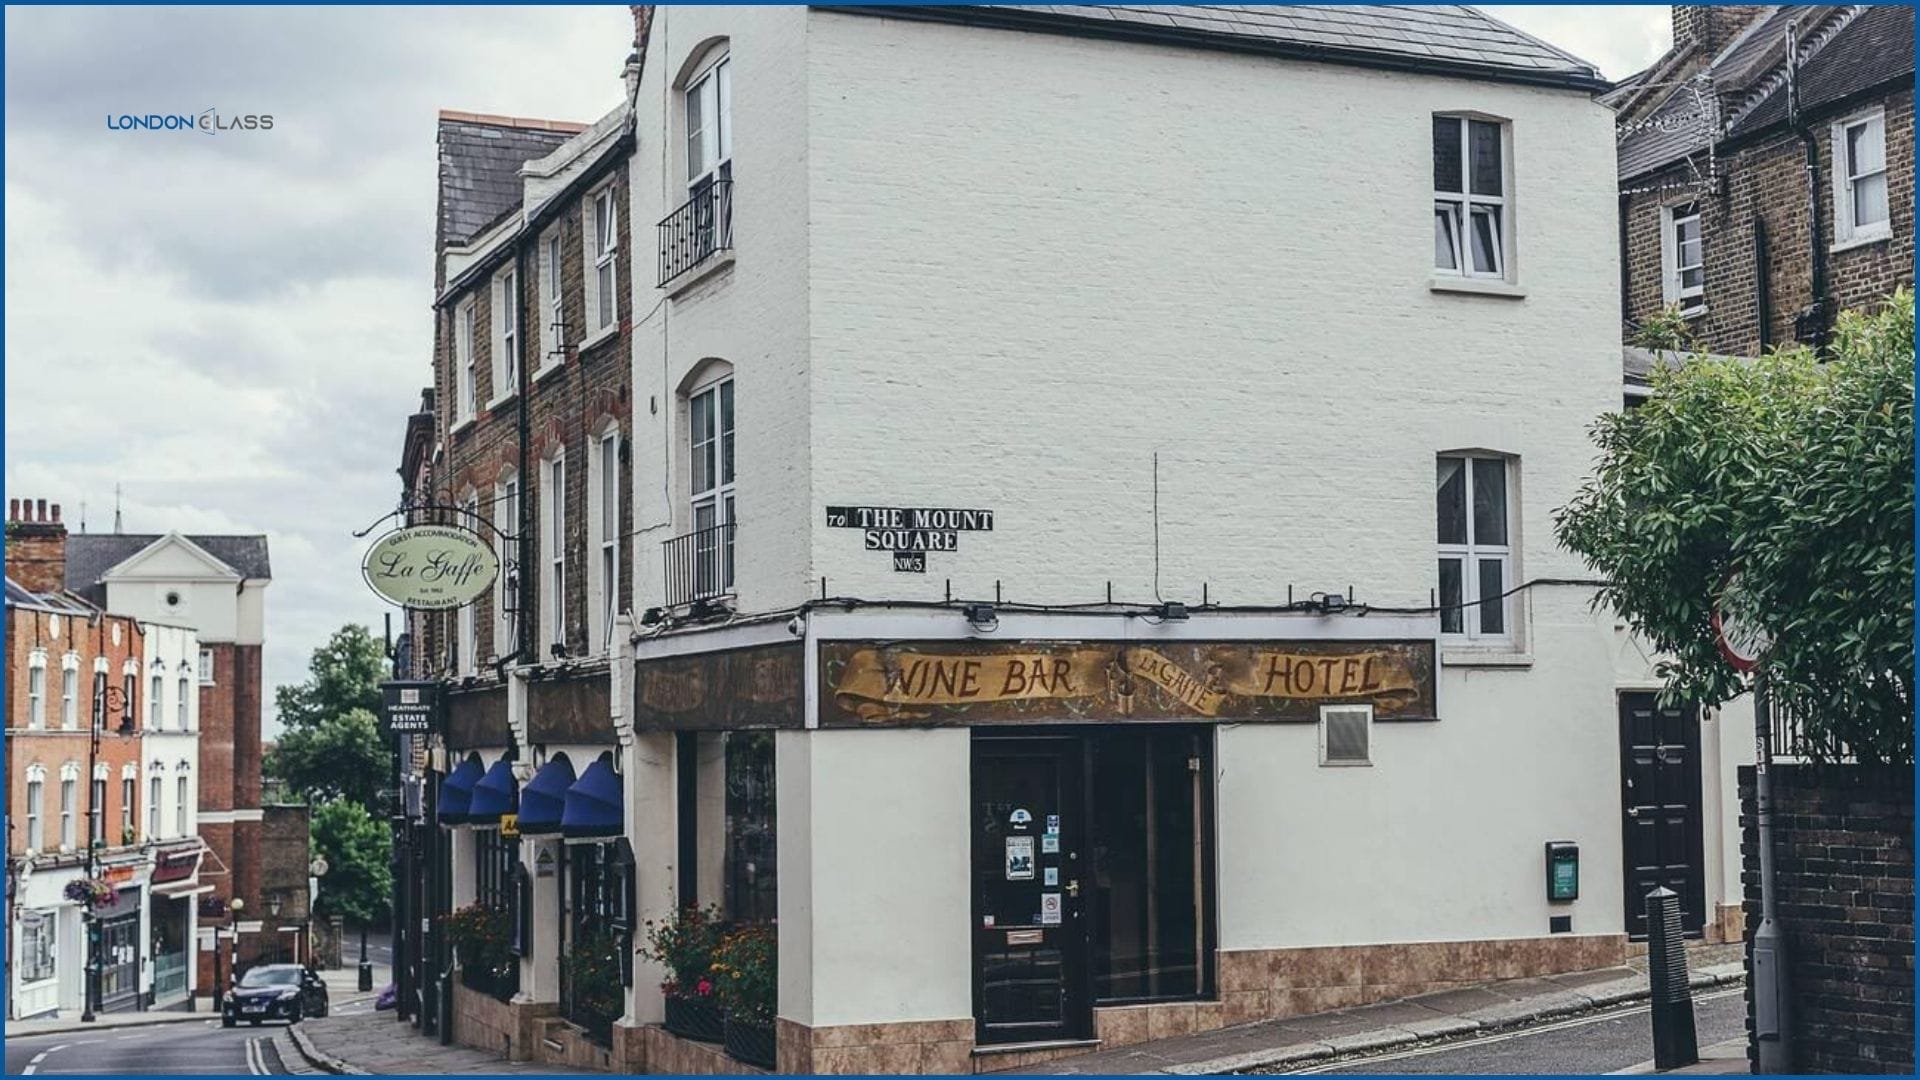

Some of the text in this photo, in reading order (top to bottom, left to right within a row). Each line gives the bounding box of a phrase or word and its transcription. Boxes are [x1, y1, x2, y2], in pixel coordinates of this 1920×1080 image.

[828, 508, 993, 530] TO THE MOUNT
[866, 531, 957, 550] SQUARE
[377, 549, 484, 586] La Gaffe
[885, 658, 1076, 698] WINE BAR
[1264, 655, 1380, 694] HOTEL
[390, 721, 429, 729] AGENTS
[392, 714, 426, 722] ESTATE
